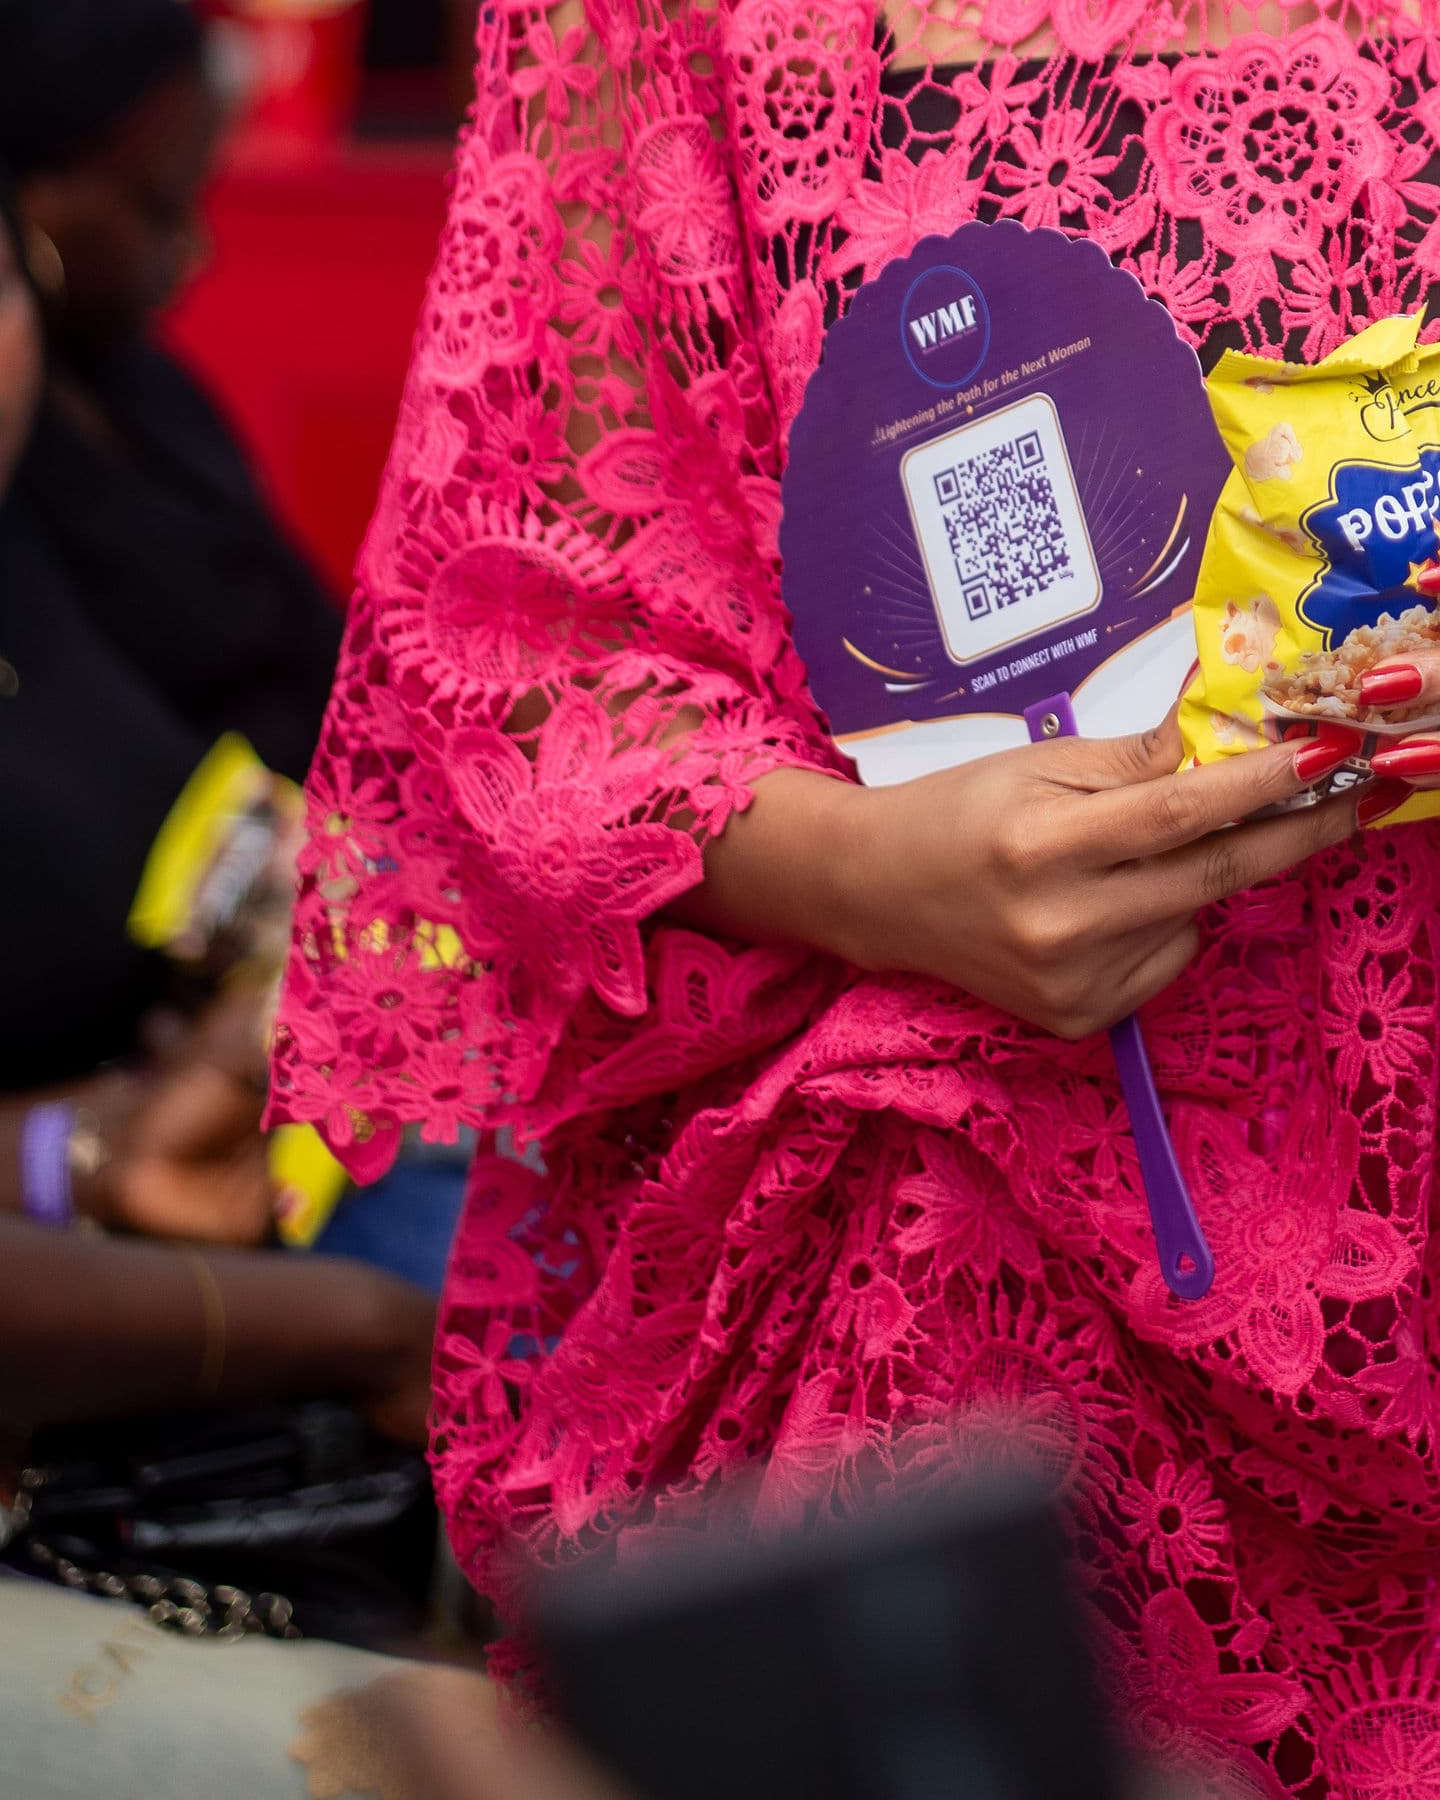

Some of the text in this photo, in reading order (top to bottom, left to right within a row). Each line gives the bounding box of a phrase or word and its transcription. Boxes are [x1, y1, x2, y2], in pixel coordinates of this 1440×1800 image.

[909, 294, 977, 349] WMF
[937, 398, 955, 415] the
[956, 384, 981, 406] Path
[982, 378, 999, 398] for
[1001, 369, 1019, 386] the
[1021, 355, 1047, 376] Next
[1048, 336, 1091, 363] Woman
[971, 628, 1098, 693] SCAN TO CONNECT WITH WMF
